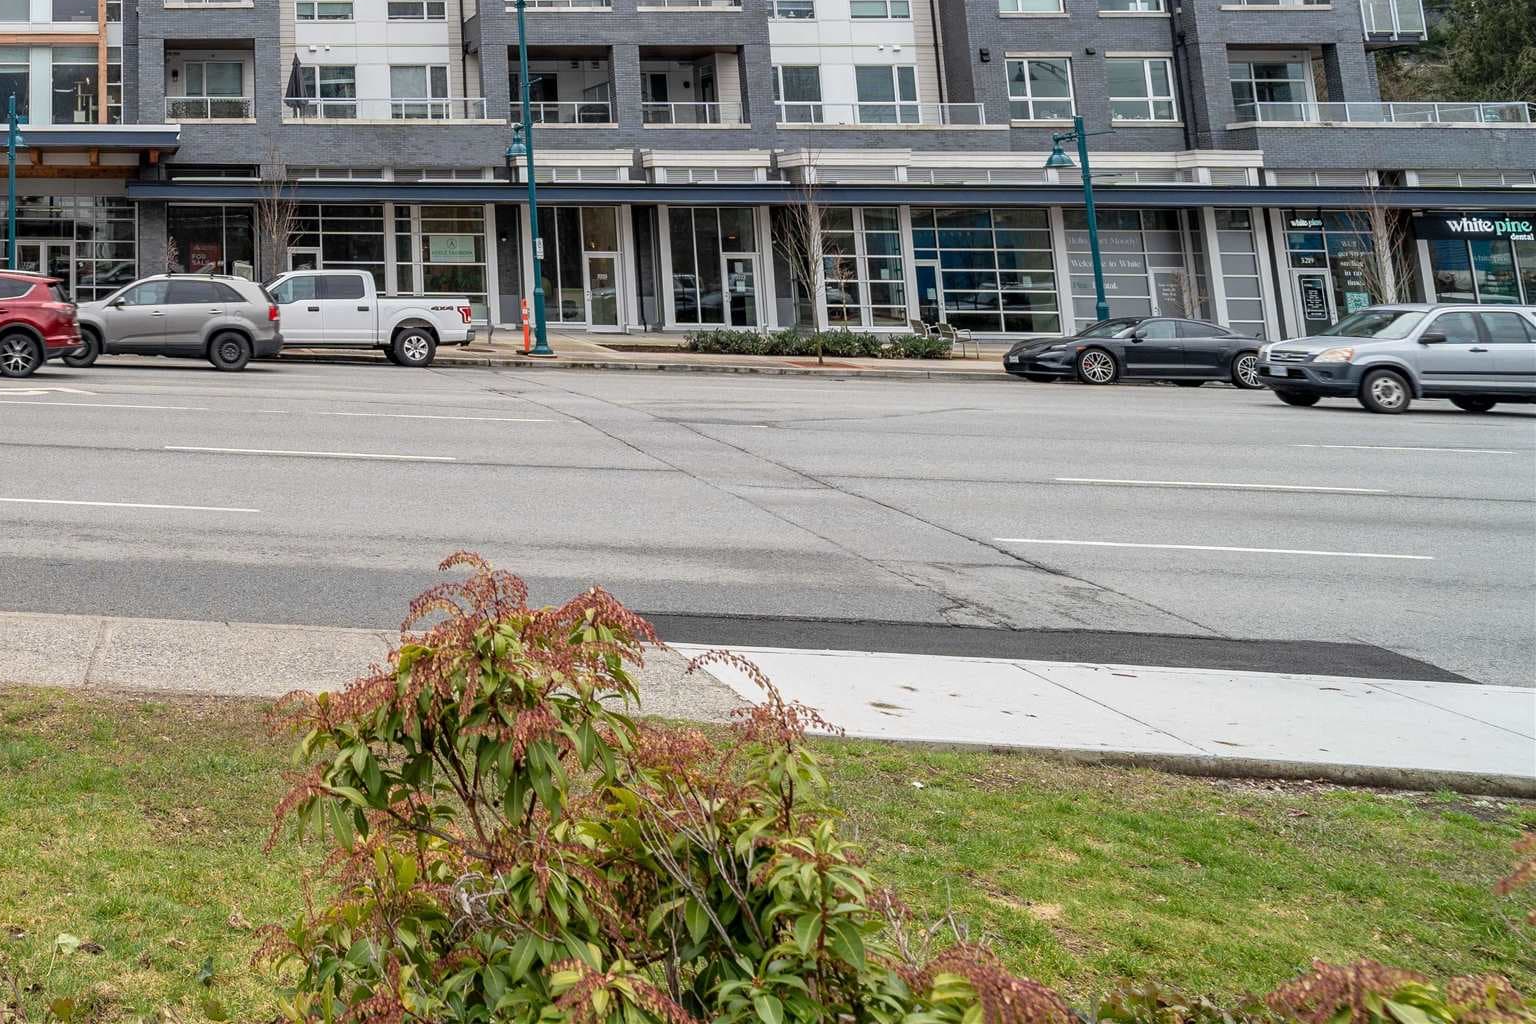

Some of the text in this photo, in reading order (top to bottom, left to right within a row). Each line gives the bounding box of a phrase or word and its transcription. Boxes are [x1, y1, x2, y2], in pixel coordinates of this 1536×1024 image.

[1446, 217, 1532, 235] white pine
[1510, 233, 1534, 241] dental
